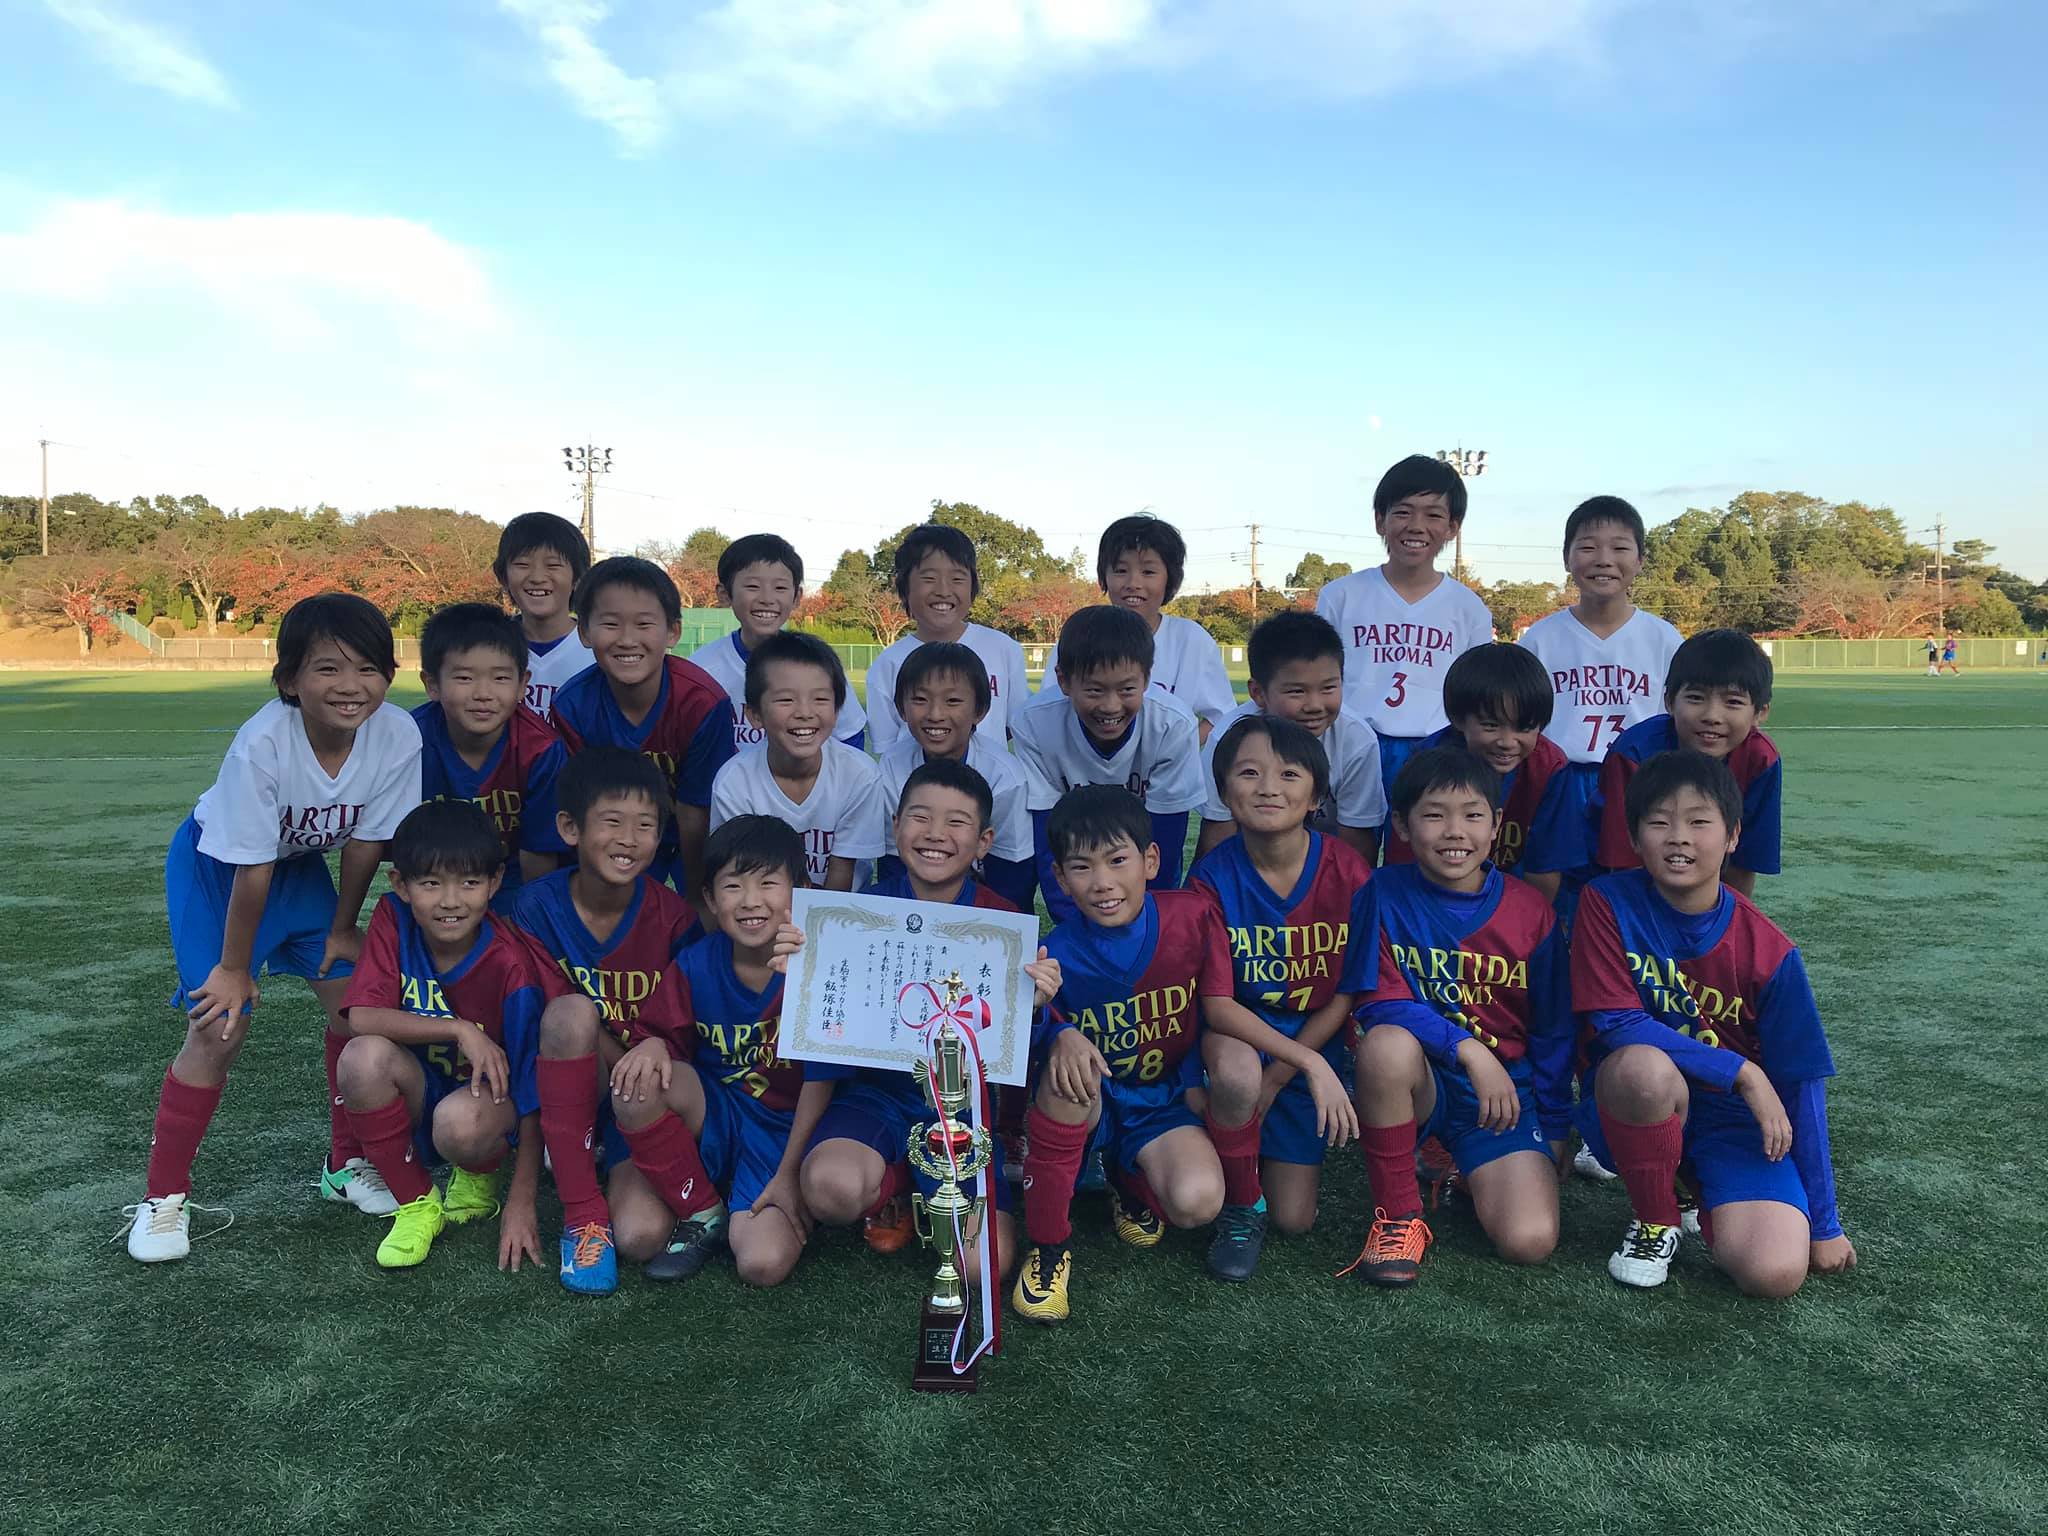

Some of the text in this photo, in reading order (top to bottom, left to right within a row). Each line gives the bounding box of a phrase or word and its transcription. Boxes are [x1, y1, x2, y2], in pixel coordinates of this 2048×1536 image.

[1352, 623, 1454, 655] PARTIDA
[1373, 646, 1433, 668] IKOMA
[1384, 671, 1408, 708] 3
[1551, 664, 1650, 698] PARTIDA
[1582, 714, 1627, 753] 73
[280, 804, 366, 833] ARTI
[558, 958, 662, 1002] RTID
[1242, 955, 1330, 984] IKOMA
[1391, 943, 1529, 990] PARTIDA
[593, 998, 641, 1022] OMA
[1652, 988, 1715, 1025] IKO
[1111, 1048, 1165, 1082] 78
